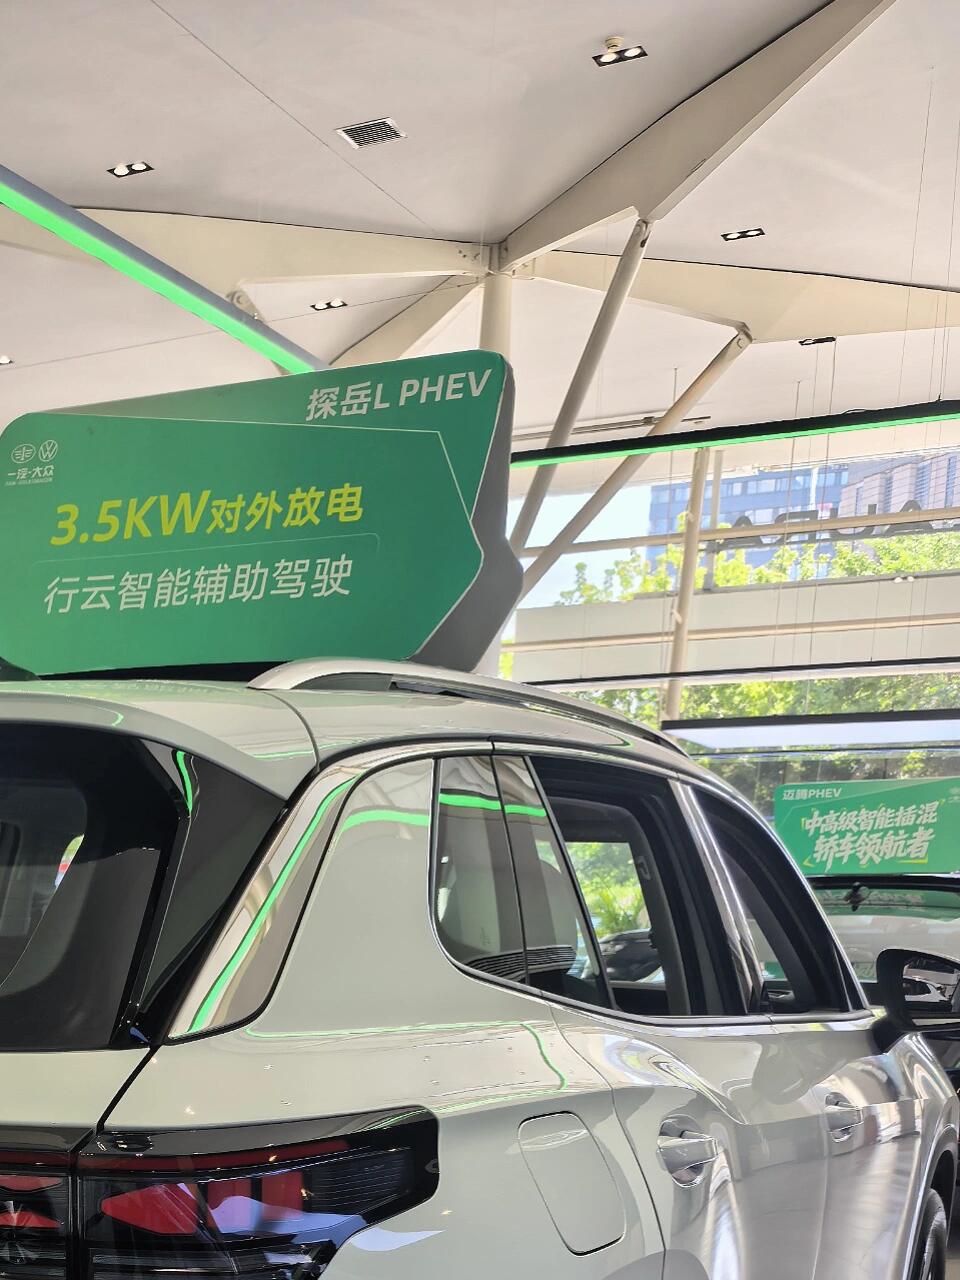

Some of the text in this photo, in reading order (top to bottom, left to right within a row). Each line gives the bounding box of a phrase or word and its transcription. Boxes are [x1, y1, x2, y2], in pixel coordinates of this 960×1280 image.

[305, 368, 493, 421] 探岳L PHEV
[49, 483, 365, 546] 3.5KW对外放电
[43, 553, 354, 615] 行云智能辅助驾驶
[804, 801, 939, 838] 中高级智能插混
[813, 827, 936, 873] 轿车领航者
